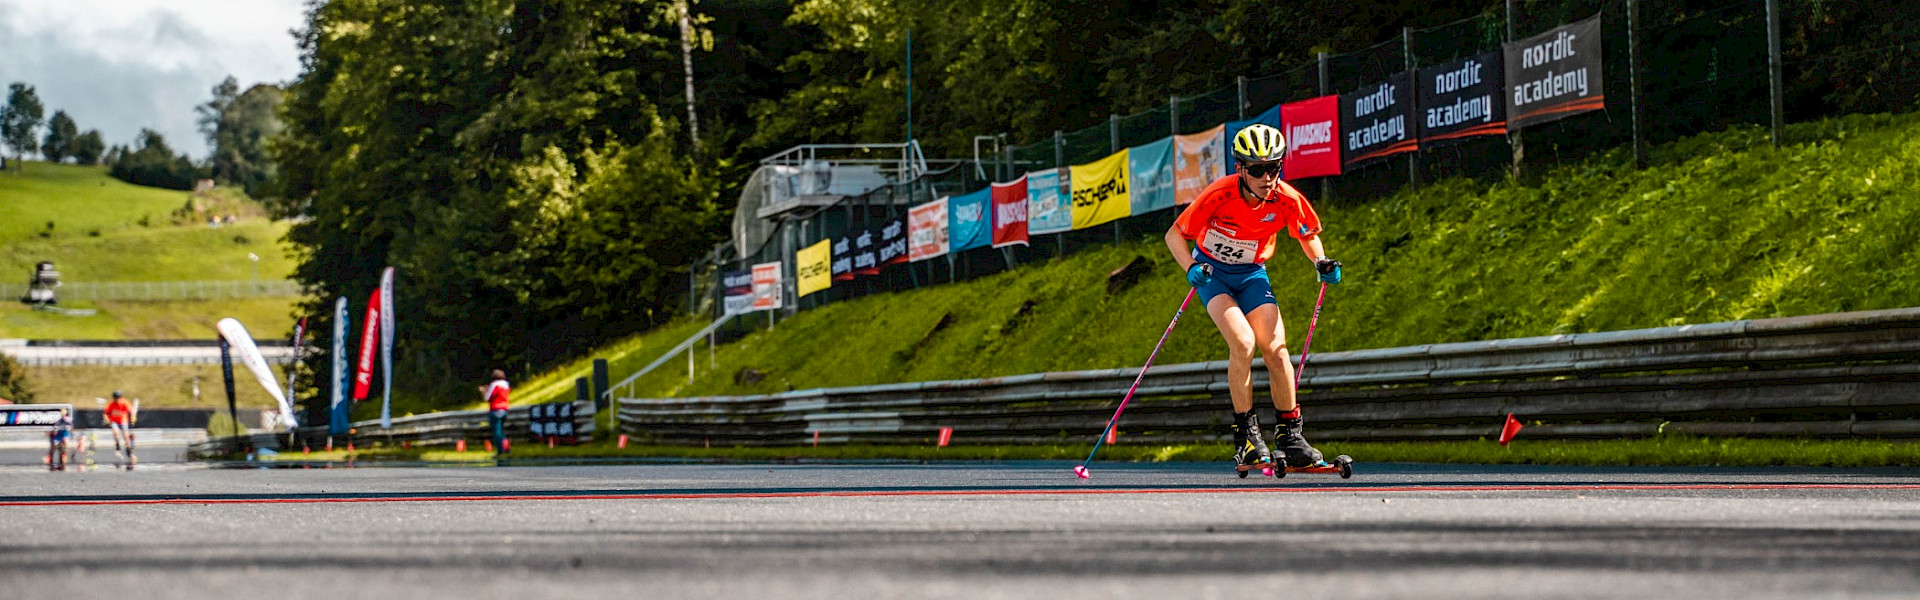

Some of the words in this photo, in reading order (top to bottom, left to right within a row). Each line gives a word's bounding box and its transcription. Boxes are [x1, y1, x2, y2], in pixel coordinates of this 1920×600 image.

[1523, 31, 1576, 69] nordic
[1435, 60, 1482, 94] nordic
[1514, 67, 1588, 106] academy
[1355, 82, 1396, 118] nordic
[1427, 95, 1492, 129] academy
[1349, 114, 1405, 151] academy
[1214, 242, 1245, 260] 124
